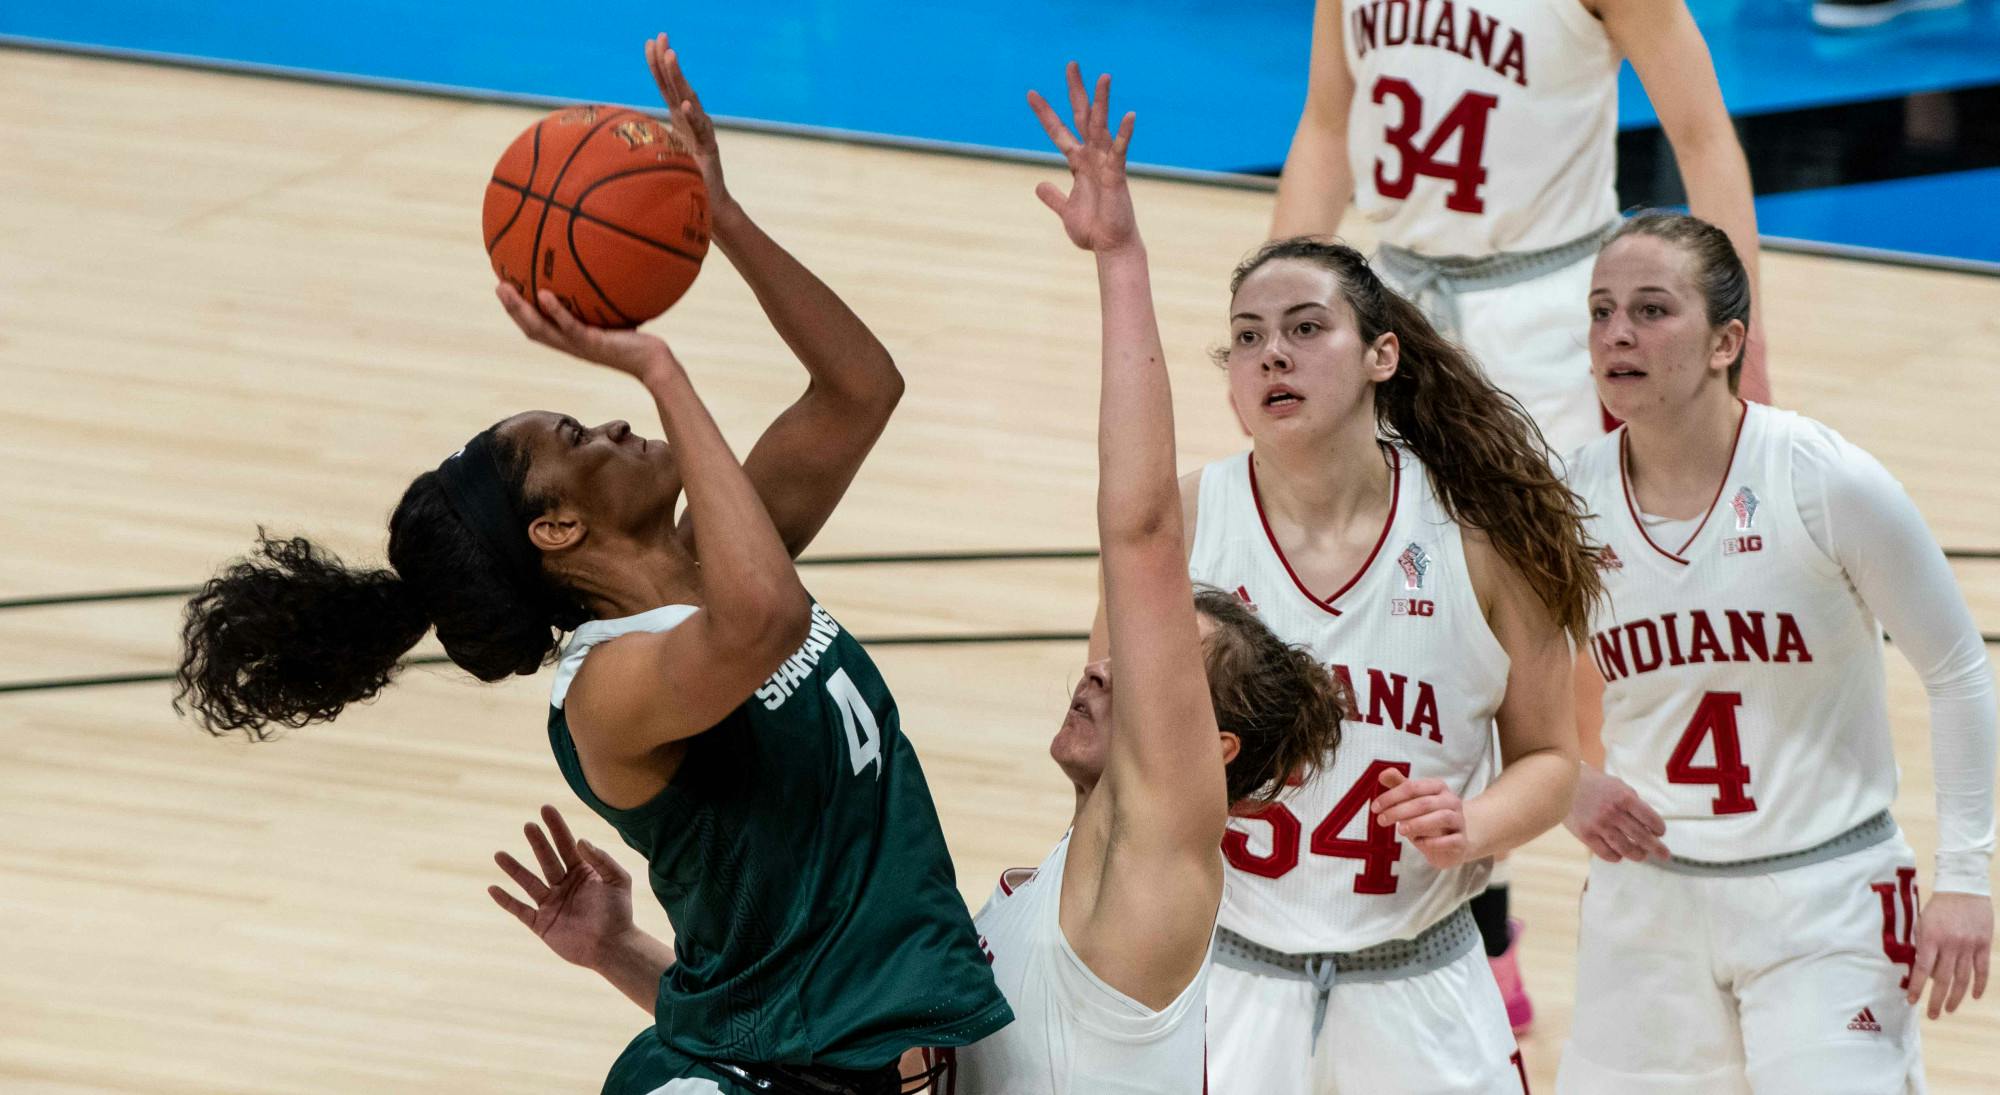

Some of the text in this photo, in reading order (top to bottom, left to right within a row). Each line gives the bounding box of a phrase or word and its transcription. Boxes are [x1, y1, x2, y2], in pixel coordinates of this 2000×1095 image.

[1371, 74, 1499, 215] 34
[754, 602, 840, 711] SPARANS
[825, 666, 882, 782] 4
[1665, 690, 1758, 815] 4
[1219, 758, 1412, 895] 54
